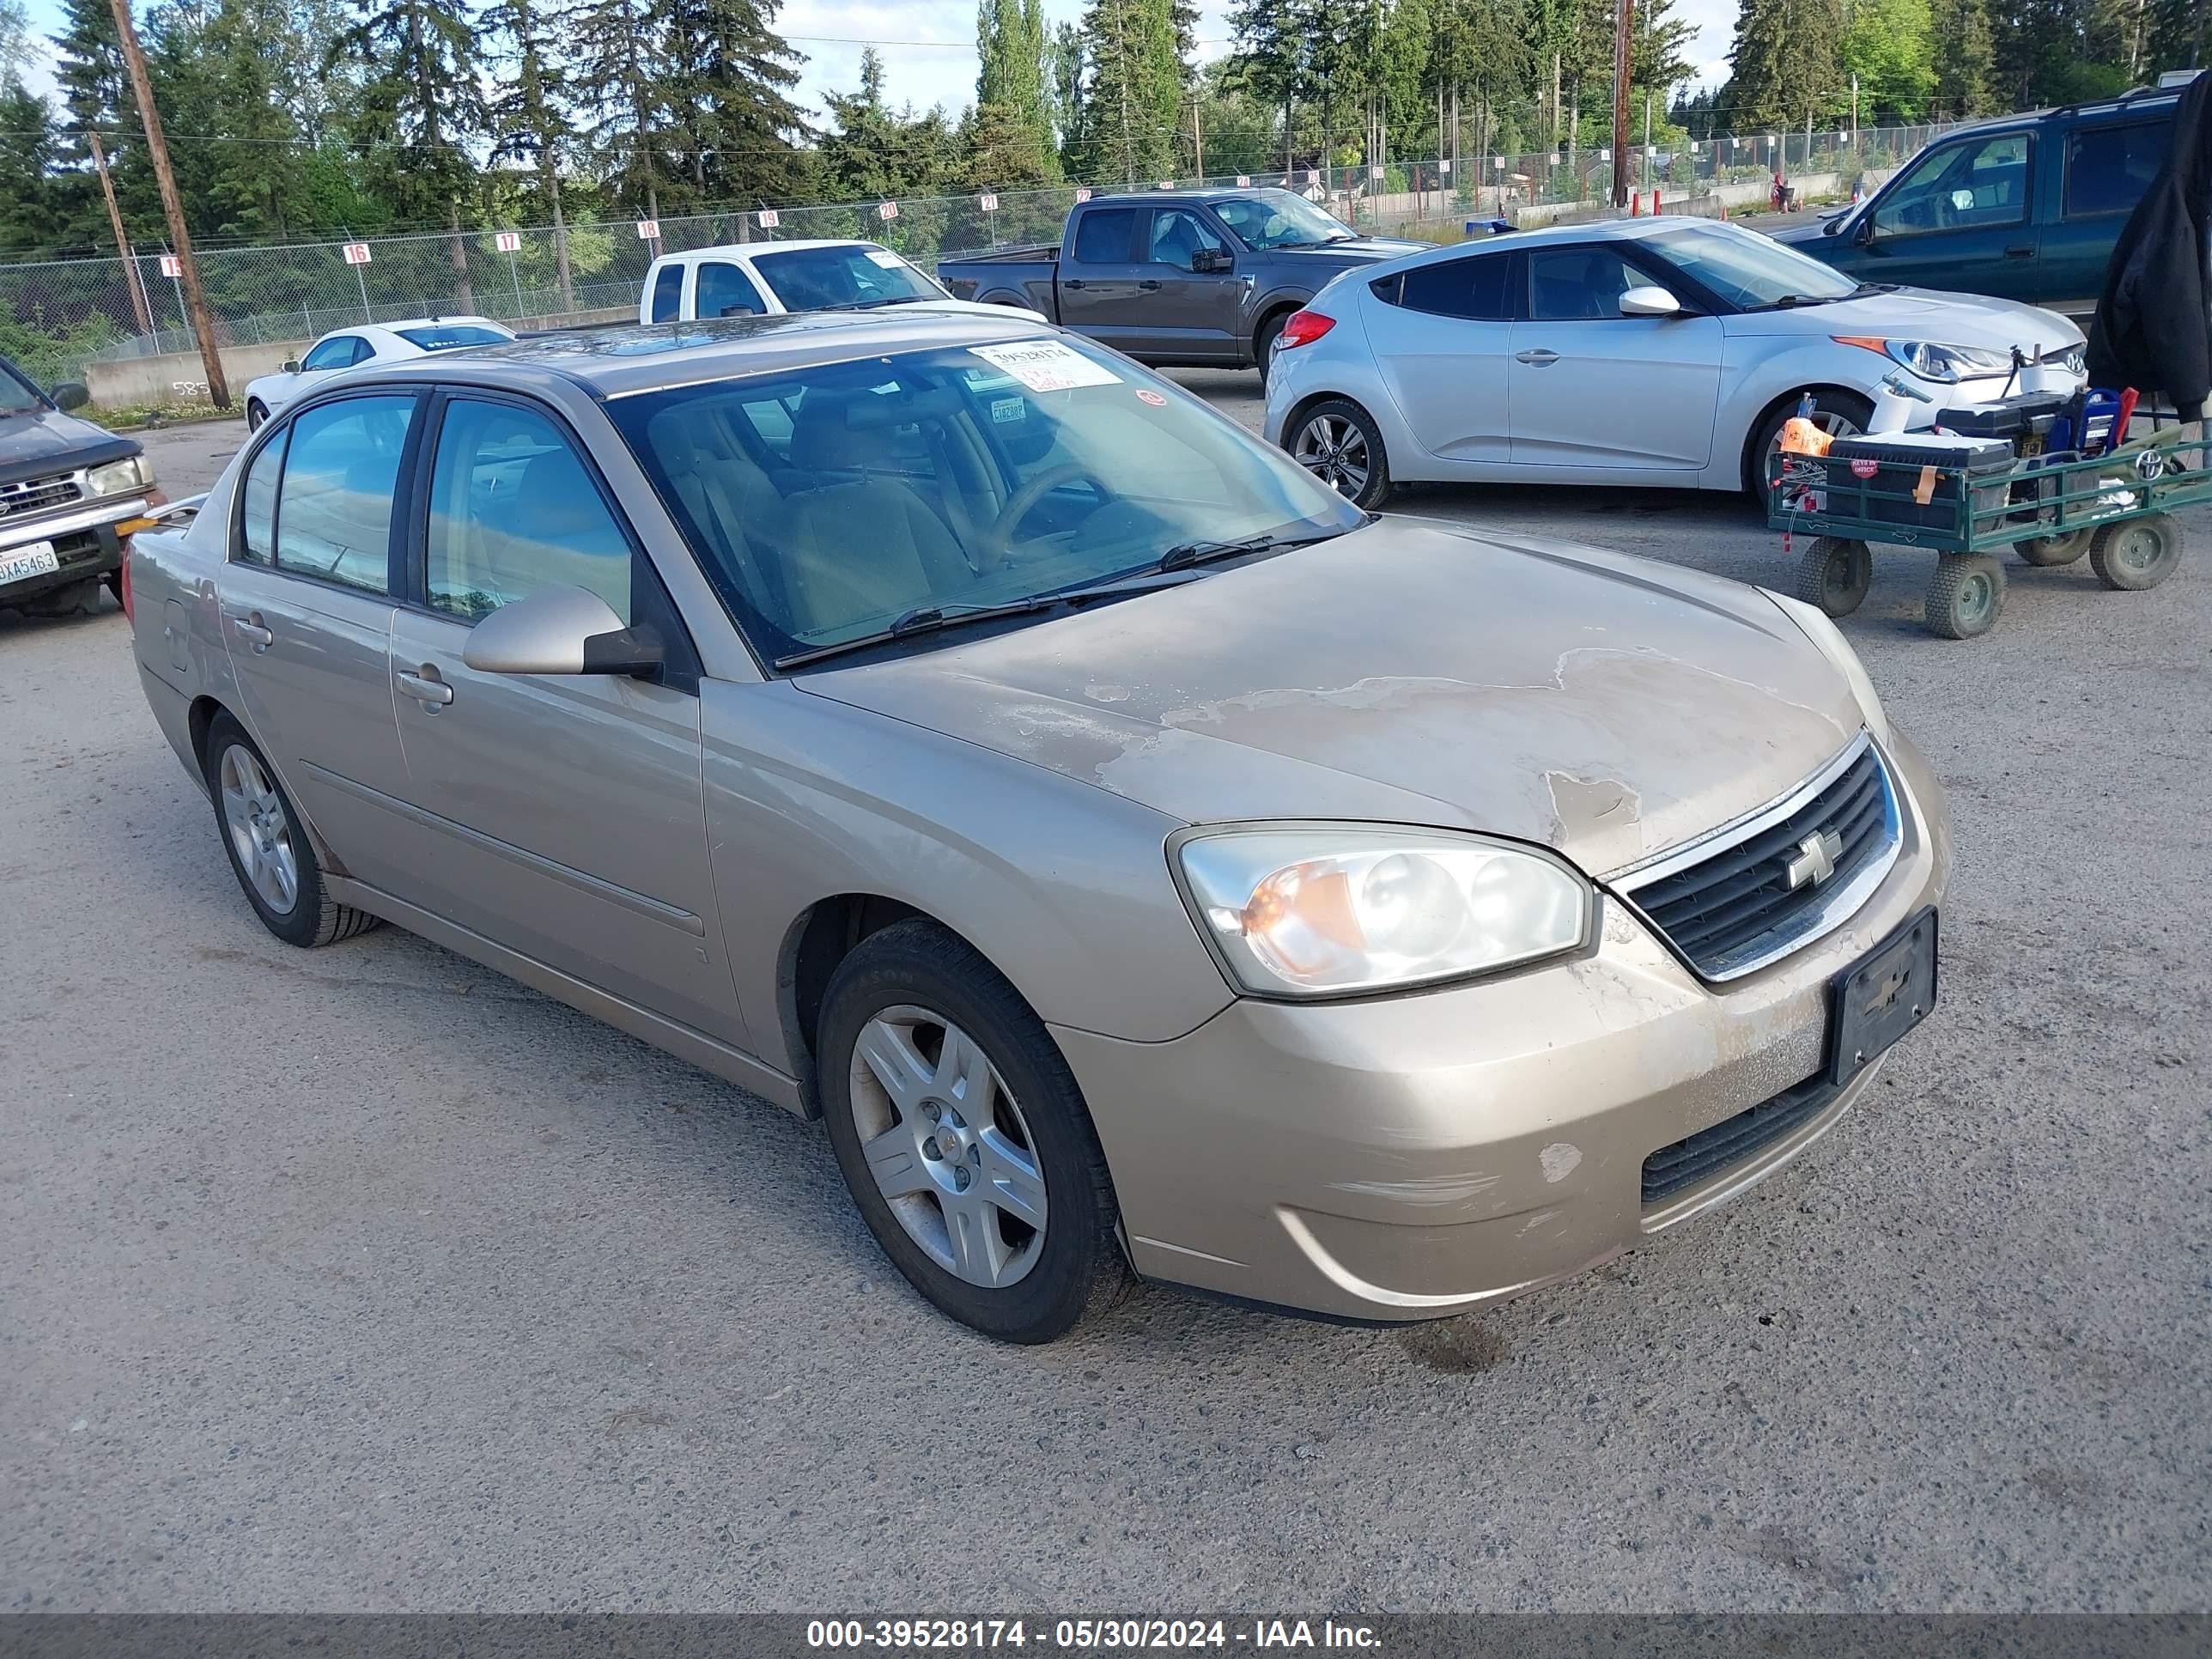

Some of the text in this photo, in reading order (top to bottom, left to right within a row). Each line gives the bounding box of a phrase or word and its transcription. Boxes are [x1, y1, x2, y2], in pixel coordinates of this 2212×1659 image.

[1374, 167, 1383, 177] 26
[1441, 161, 1448, 171] 27
[1310, 172, 1318, 183] 25
[881, 203, 896, 218] 20
[984, 196, 995, 210] 21
[762, 212, 776, 227] 19
[641, 222, 657, 237] 18
[501, 234, 514, 250] 17
[348, 245, 367, 262] 16
[173, 381, 211, 396] 585
